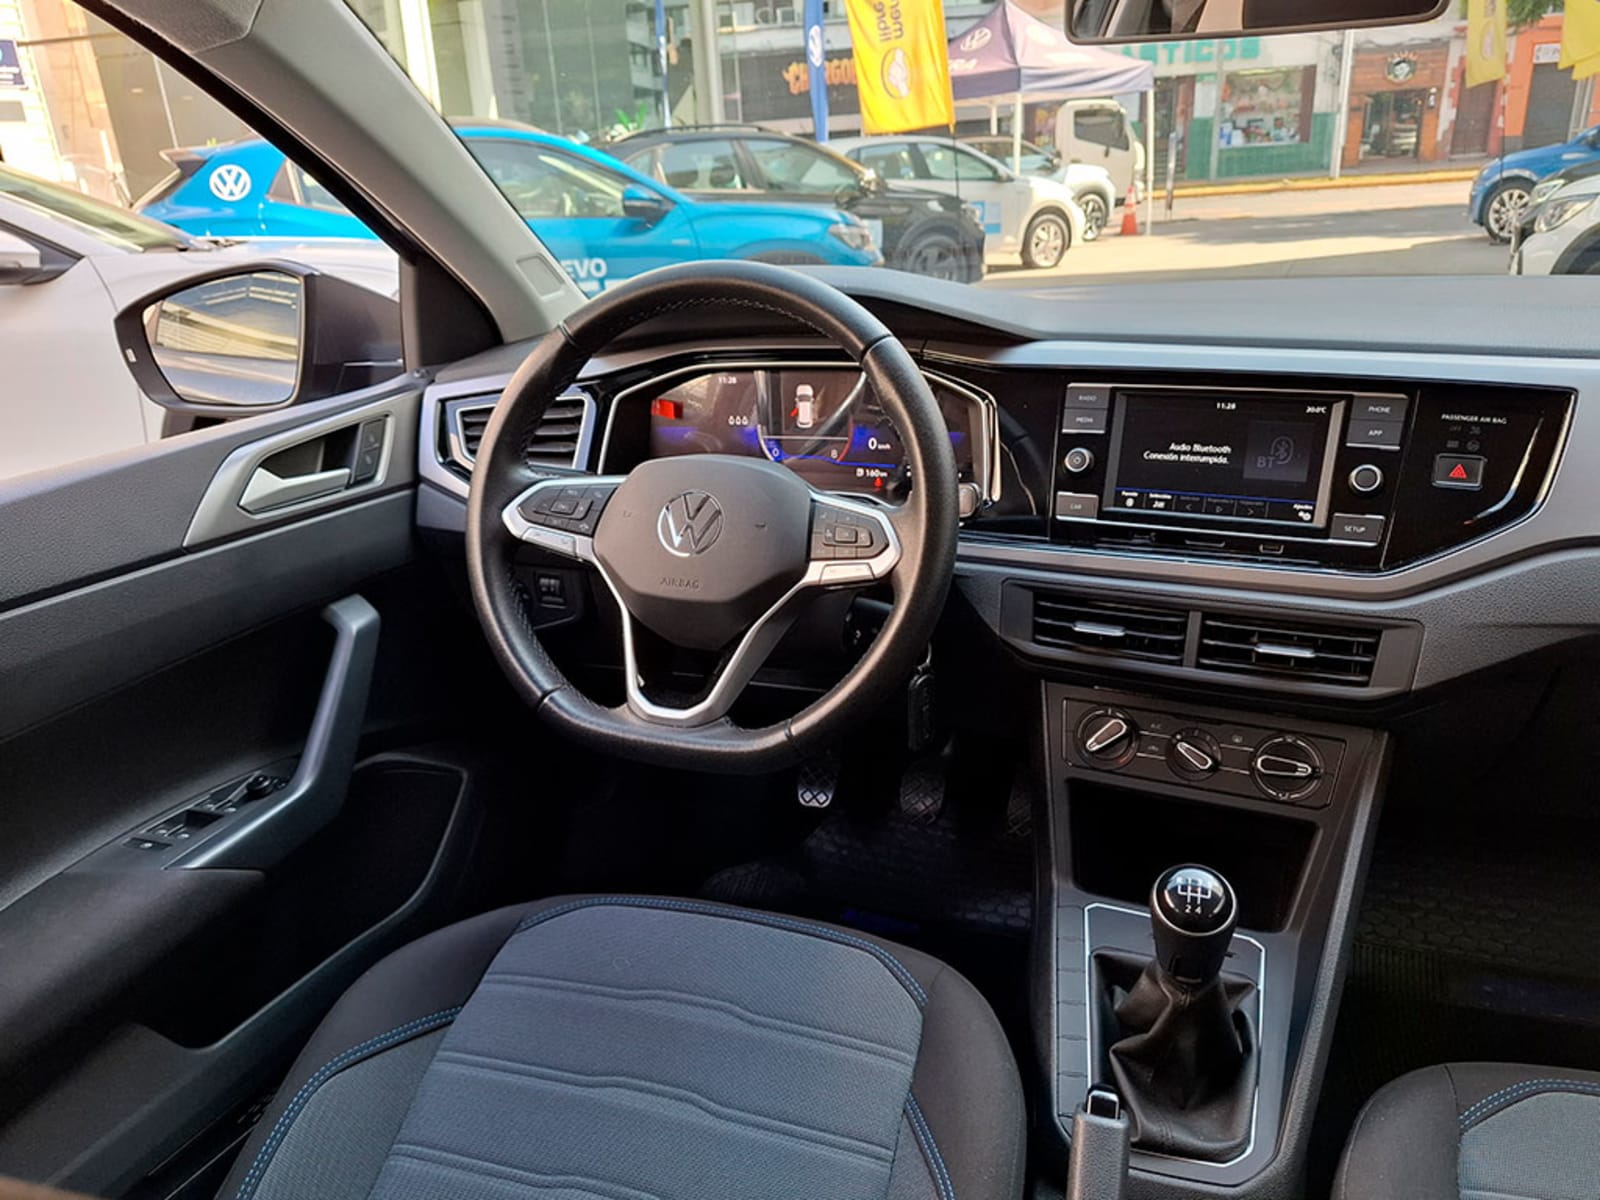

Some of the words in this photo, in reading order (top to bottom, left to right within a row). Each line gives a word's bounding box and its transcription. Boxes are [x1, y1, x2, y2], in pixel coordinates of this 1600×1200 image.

[1216, 402, 1236, 410] 11:28
[1368, 406, 1391, 414] PHONE
[1441, 413, 1478, 423] PASSENGER
[1492, 417, 1507, 425] BAG
[1368, 429, 1383, 437] APP
[868, 437, 877, 451] 0
[1169, 442, 1191, 452] Audio
[1192, 443, 1232, 454] Bluetooth
[1256, 455, 1275, 469] BT
[1344, 525, 1366, 533] SETUP
[660, 577, 700, 590] AIRBAG
